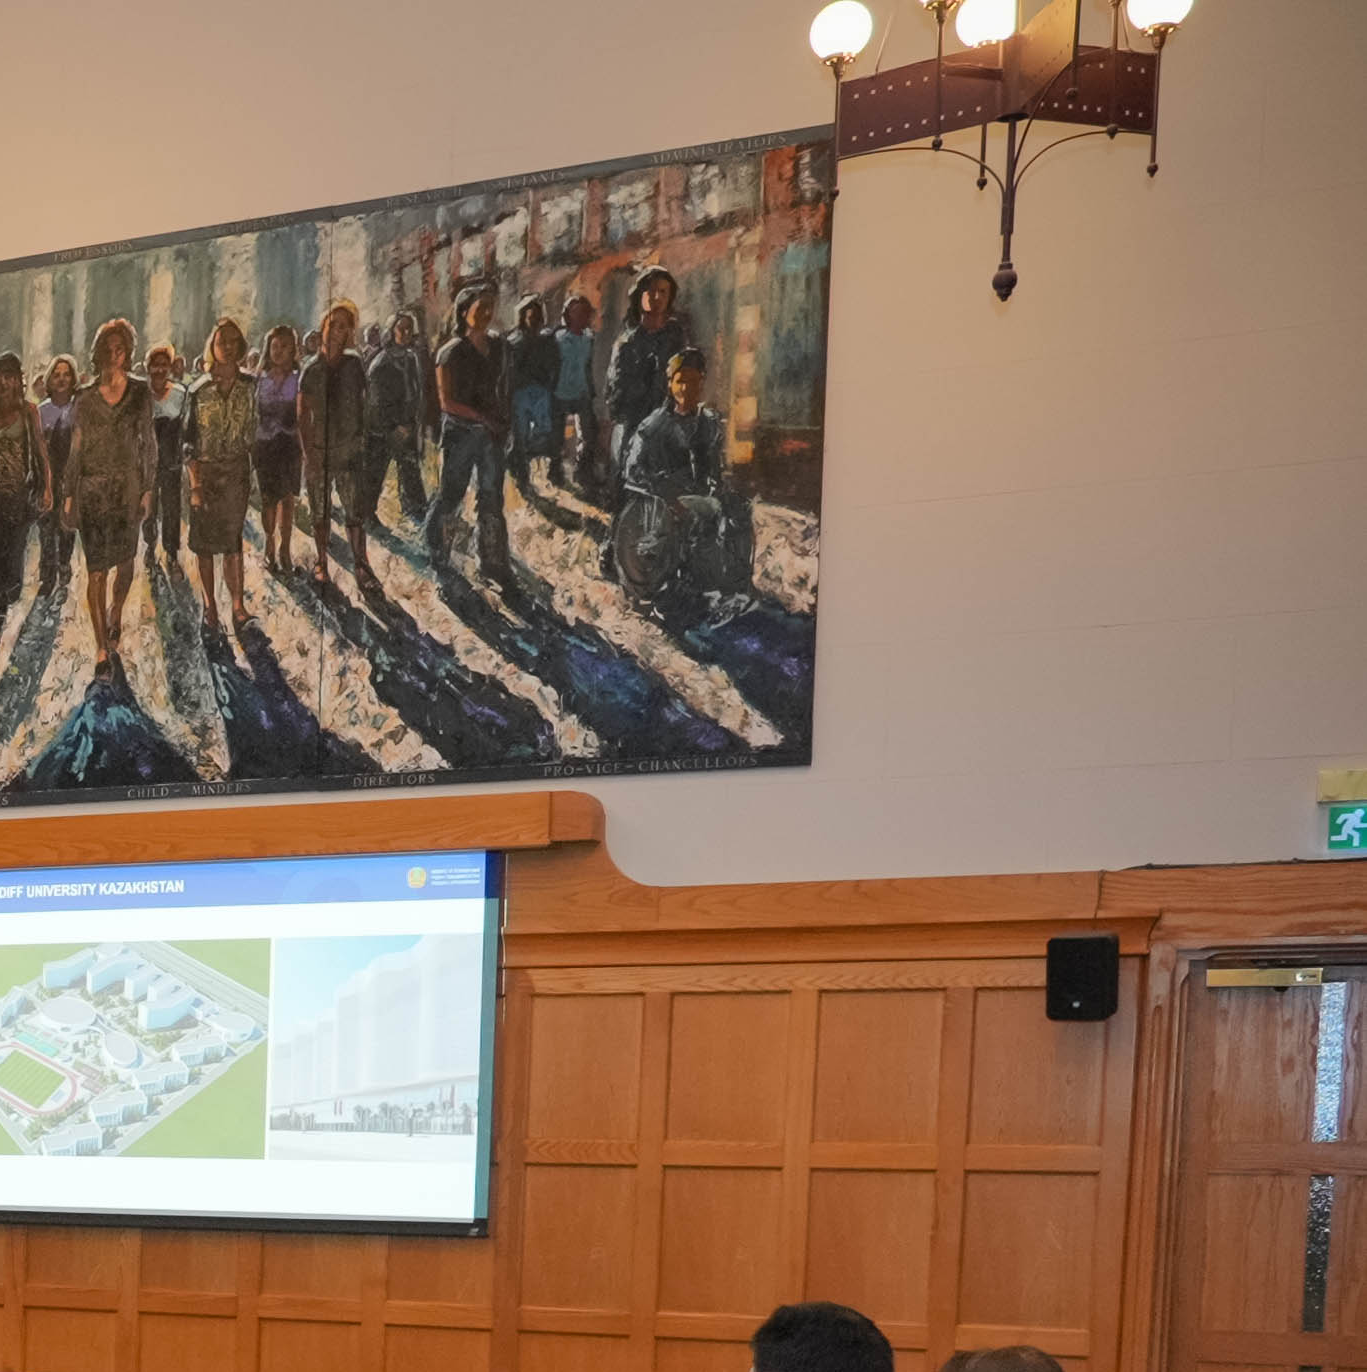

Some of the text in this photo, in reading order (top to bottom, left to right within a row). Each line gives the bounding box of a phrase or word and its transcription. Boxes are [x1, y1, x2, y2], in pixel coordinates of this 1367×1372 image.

[352, 773, 435, 787] DIRECTORS
[26, 883, 96, 898] UNIVERSITY
[99, 879, 185, 896] KAZAKHSTAN
